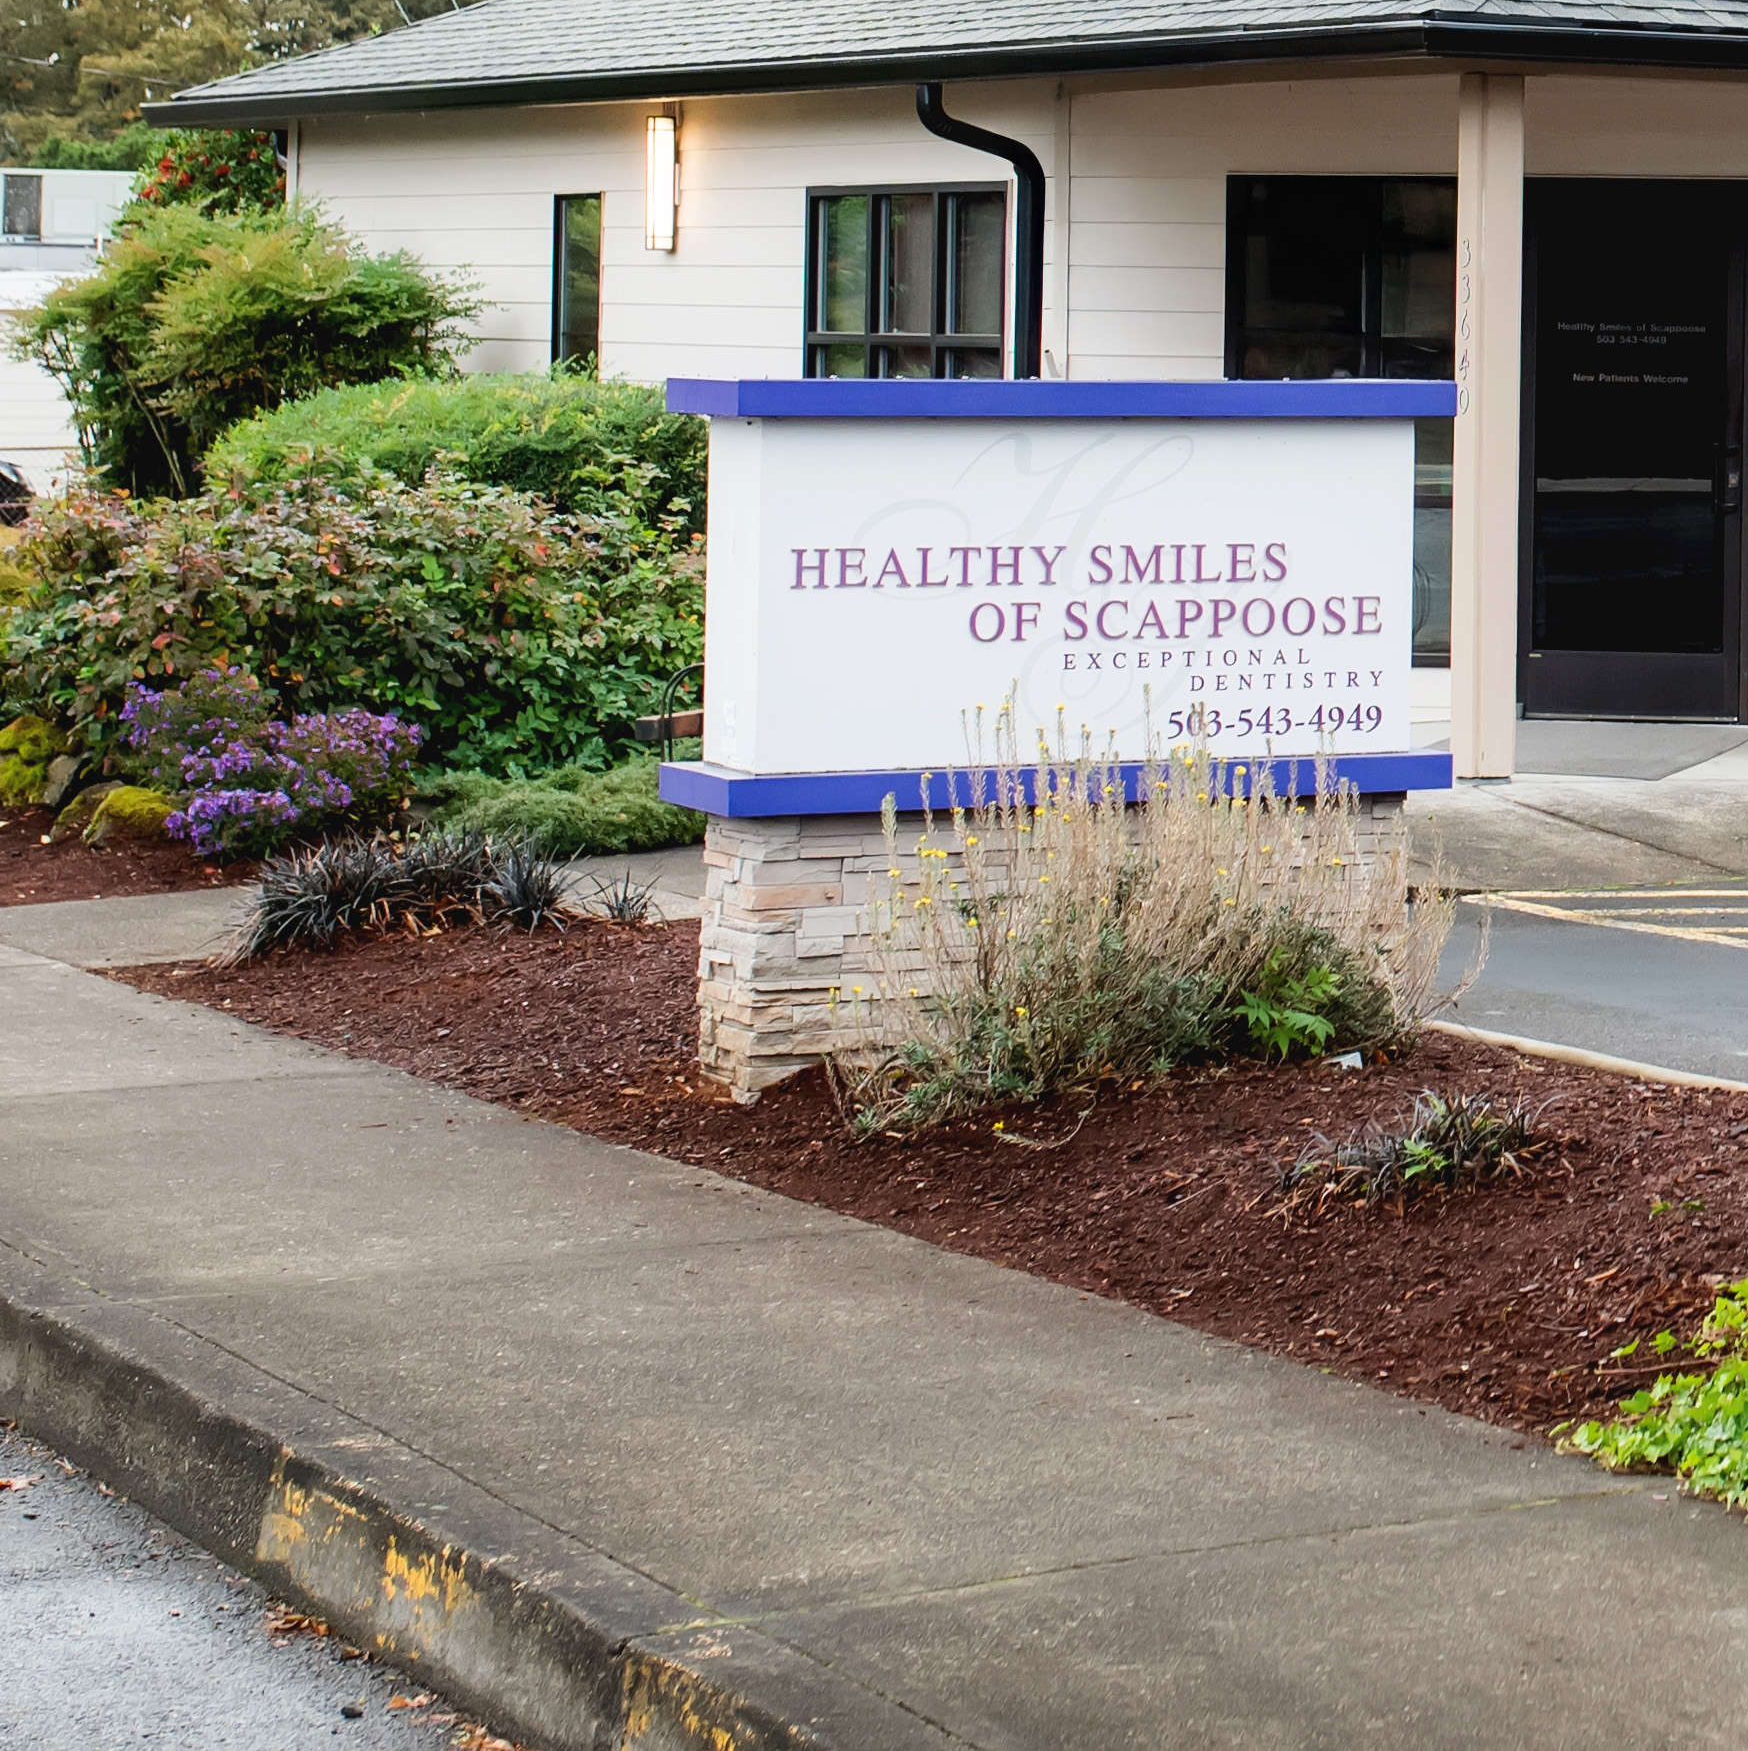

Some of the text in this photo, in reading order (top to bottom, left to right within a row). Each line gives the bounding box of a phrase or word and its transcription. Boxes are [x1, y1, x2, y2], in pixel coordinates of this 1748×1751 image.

[1459, 238, 1471, 415] 33640
[1557, 322, 1706, 333] Healthy Smiles of Scappoose
[1596, 335, 1615, 344] 503
[1572, 373, 1689, 383] New Patients Welcome
[790, 542, 1288, 590] HEALTHY SMILES
[969, 595, 1383, 643] OF SCAPPOOSE
[1063, 648, 1311, 670] EXCEPTIONAL
[1190, 670, 1384, 692] DENTISTRY
[1167, 703, 1383, 739] 503-543-4949
